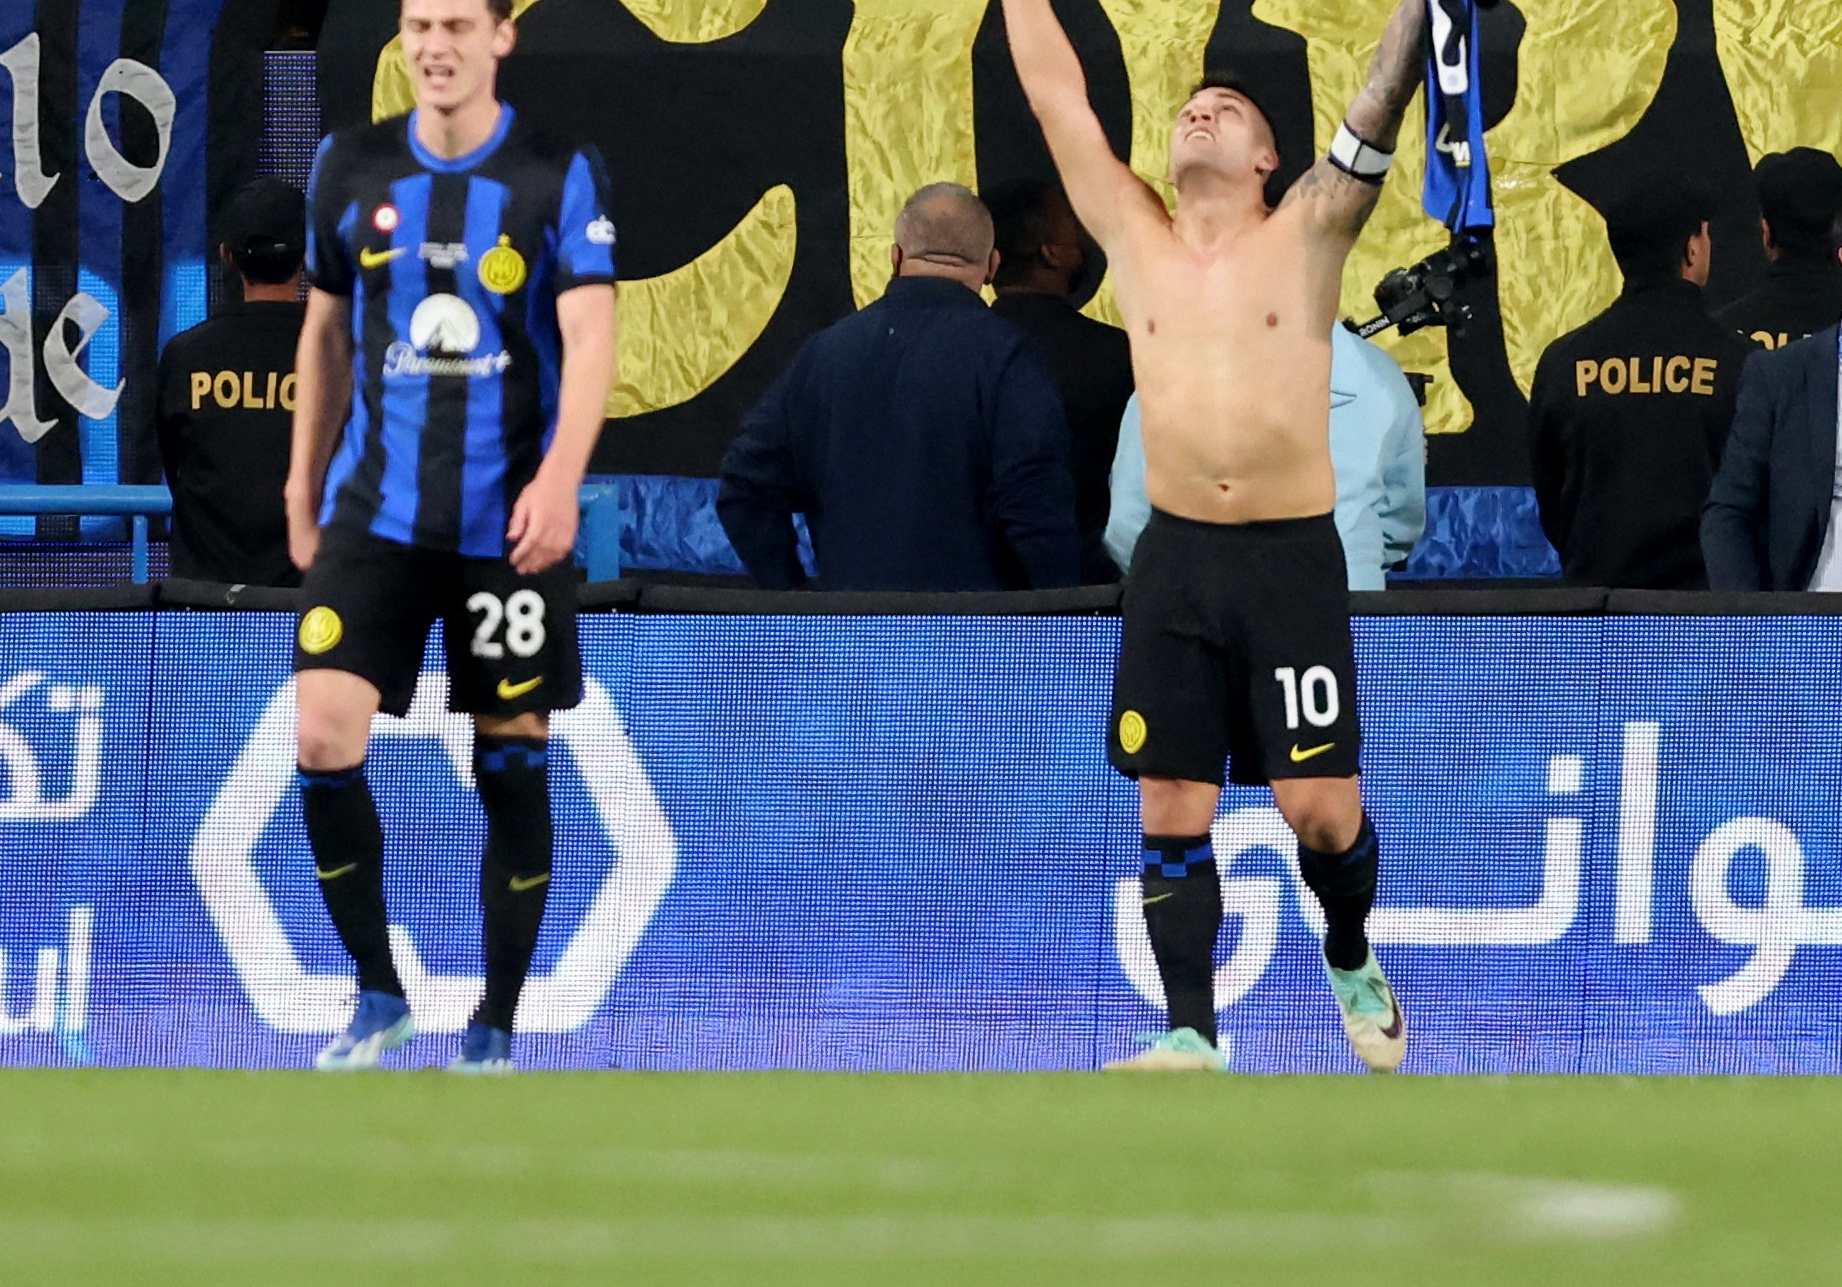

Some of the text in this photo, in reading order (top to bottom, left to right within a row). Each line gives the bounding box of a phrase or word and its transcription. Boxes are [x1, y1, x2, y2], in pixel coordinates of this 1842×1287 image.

[1357, 315, 1391, 337] RONIN
[190, 369, 298, 412] POLIC
[1574, 354, 1719, 396] POLICE
[465, 589, 547, 659] 28
[1273, 664, 1341, 730] 10
